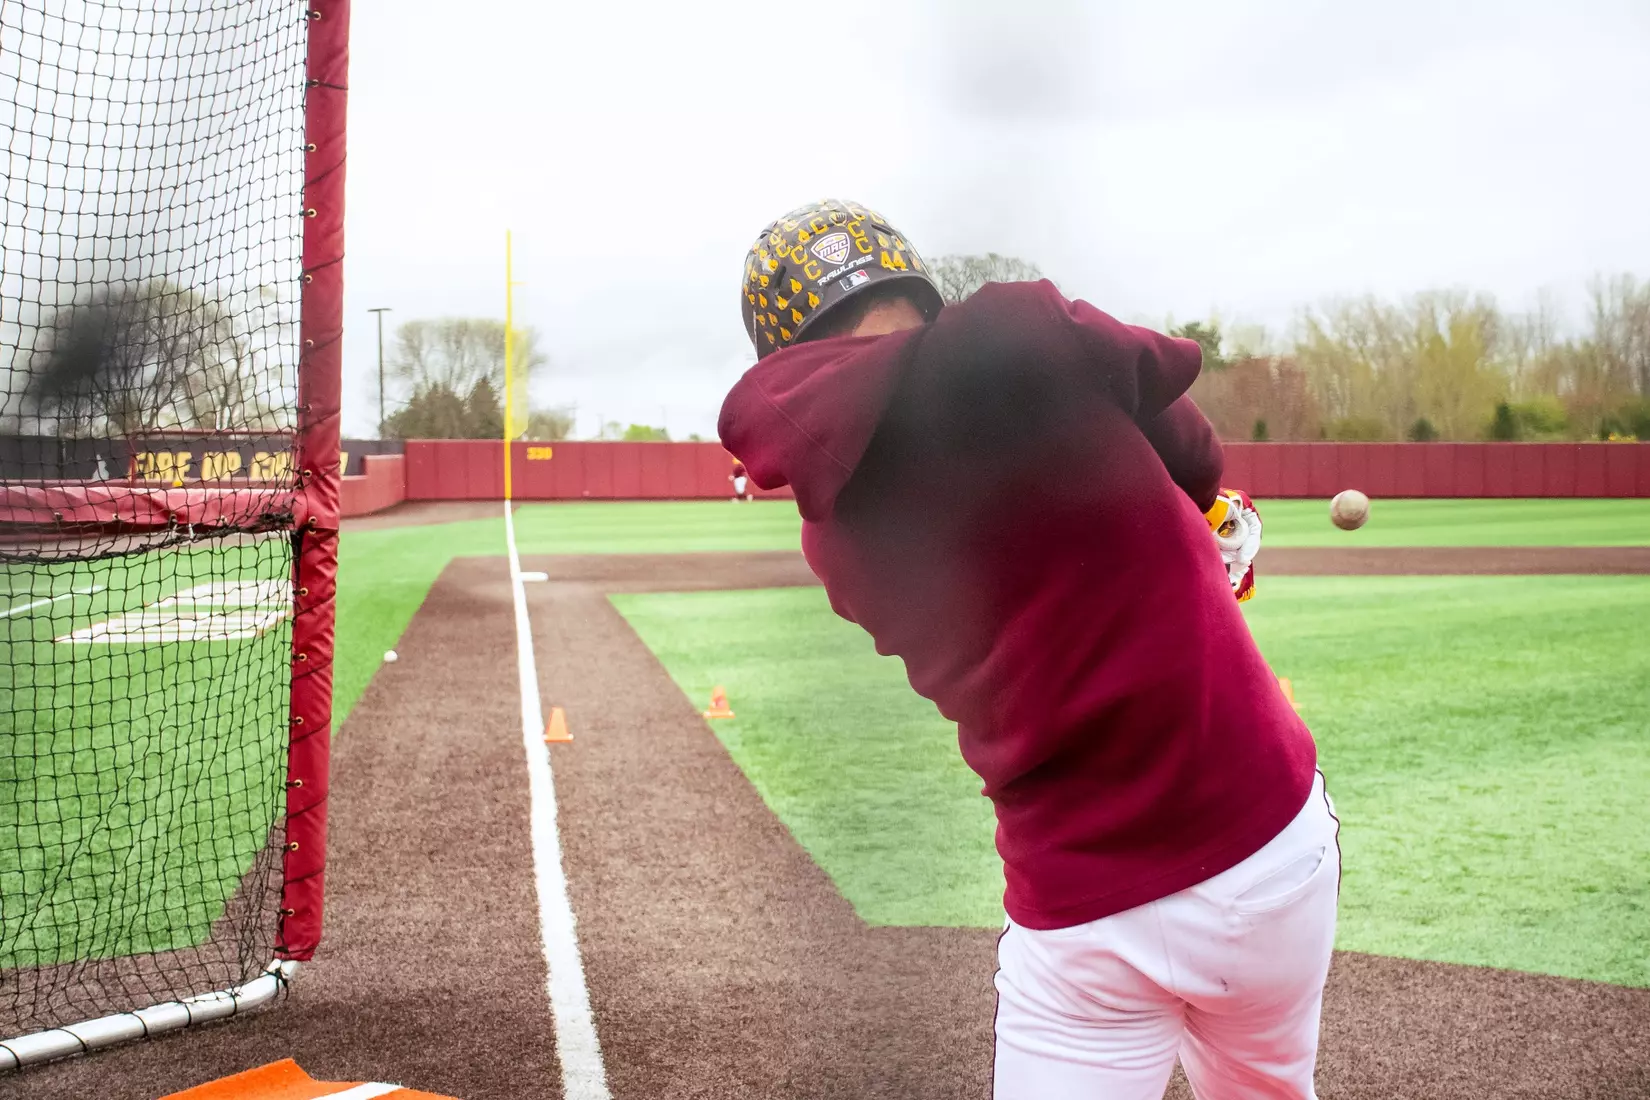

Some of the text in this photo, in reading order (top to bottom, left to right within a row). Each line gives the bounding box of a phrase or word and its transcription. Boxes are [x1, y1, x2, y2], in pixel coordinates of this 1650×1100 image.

[847, 220, 865, 238] C
[790, 244, 808, 264] C
[819, 239, 848, 258] MAC
[855, 236, 873, 253] C
[804, 260, 821, 280] C
[817, 254, 874, 286] RAWLINGS
